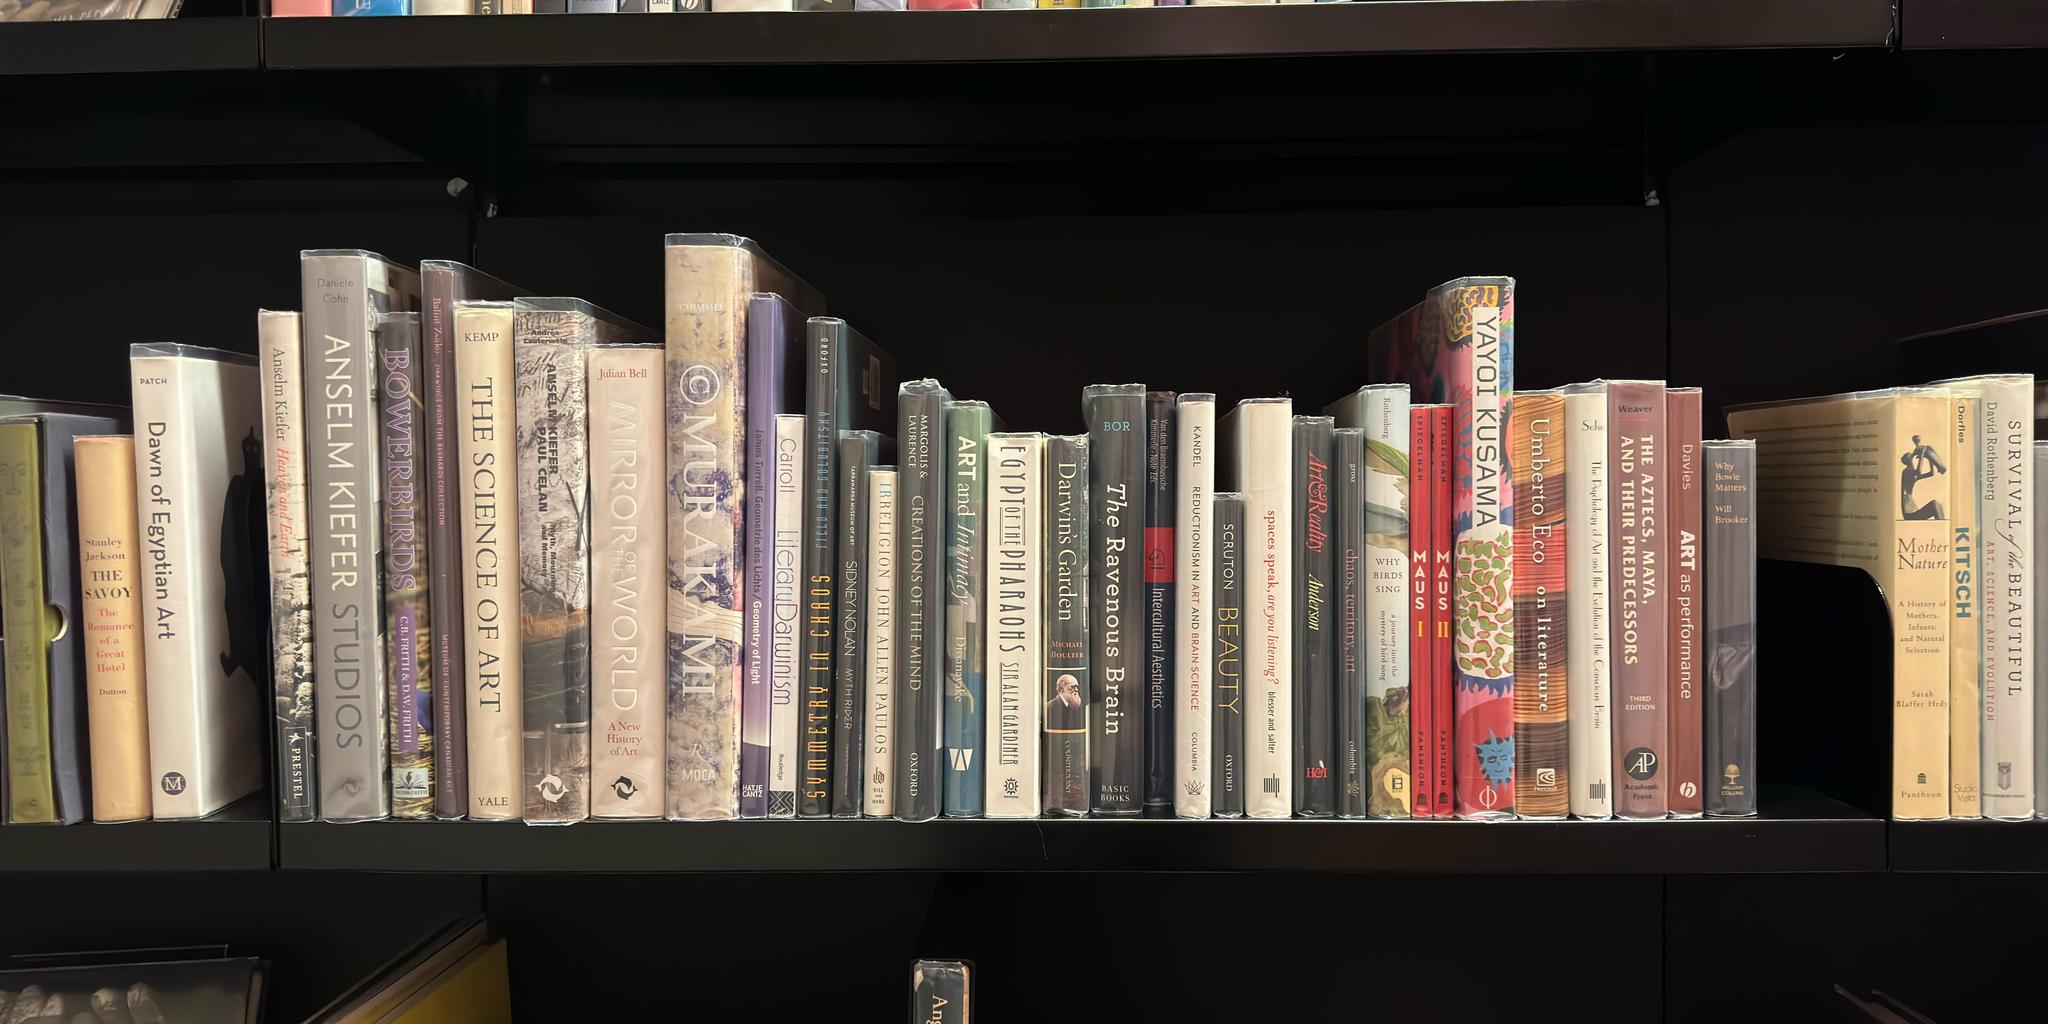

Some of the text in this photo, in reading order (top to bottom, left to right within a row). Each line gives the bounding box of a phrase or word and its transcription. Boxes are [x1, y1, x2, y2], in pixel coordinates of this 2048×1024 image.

[465, 333, 499, 342] KEMP
[820, 337, 828, 374] OXFORD
[140, 377, 167, 385] PATCH
[597, 368, 647, 380] Julian Bell
[547, 363, 558, 474] ANSELM KIEFER
[1103, 421, 1130, 432] BOR
[1381, 398, 1391, 439] Rothenberg
[1476, 316, 1497, 528] YAYOI KUSAMA
[1618, 405, 1652, 413] Weaver
[1957, 405, 1965, 443] Dorfles
[908, 415, 917, 468] LAURENCE
[919, 414, 928, 479] MARGOLIS &
[1192, 426, 1202, 466] KANDEL
[1985, 402, 1997, 501] David Rothenberg
[384, 348, 417, 592] BOWERBIRDS
[537, 426, 548, 512] PAUL CELAN
[780, 438, 796, 492] Carroll
[1682, 444, 1694, 490] Davies
[1715, 462, 1734, 471] Why
[1715, 473, 1740, 481] Bowie
[1530, 416, 1552, 563] Umberto Eco
[1715, 484, 1747, 492] Matters
[147, 420, 175, 640] Dawn of Egyptian Art
[951, 435, 977, 605] ART and Intimacy
[1640, 435, 1655, 605] THE AZTECS, MAYA,
[1715, 516, 1748, 524] Brooker
[85, 551, 126, 562] Jackson
[325, 334, 362, 749] ANSELM KIEFER STUDIOS
[472, 377, 501, 713] THE SCIENCE OF ART
[1000, 446, 1026, 653] EGYPT OF THE PHARAOHS
[1058, 462, 1078, 621] Darwin's Garden
[1223, 523, 1234, 590] SCRUTON
[1376, 558, 1400, 566] WHY
[1621, 436, 1637, 664] AND THEIR PREDECESSORS
[1898, 538, 1949, 554] Mother
[1898, 554, 1948, 570] Nature
[1995, 421, 2024, 696] SURVIVAL of the BEAUTIFUL
[84, 586, 133, 600] SAVOY
[91, 570, 122, 581] THE
[909, 495, 923, 691] CREATIONS OF THE MIND
[1375, 585, 1401, 593] SING
[1955, 527, 1971, 618] KITSCH
[97, 608, 118, 617] The
[844, 561, 857, 656] SIDNEY NOLAN
[874, 482, 893, 755] IRRELIGION JOHN ALLEN PAULOS
[1105, 483, 1128, 736] The Ravenous Brain
[1190, 486, 1201, 711] REDUCTIONISM IN ART AND BRAIN SCIENCE
[1263, 510, 1279, 685] spaces speak, are you listening?
[1678, 530, 1696, 699] ART as performance
[1907, 600, 1936, 609] History
[88, 622, 135, 632] Romance
[99, 636, 110, 645] of
[1986, 541, 1994, 721] ART, SCIENCE, AND EVOLUTION
[96, 650, 125, 659] Great
[96, 663, 126, 672] Hotel
[1151, 588, 1166, 709] Intercultural Aesthetics
[1218, 607, 1239, 714] BEAUTY
[1380, 648, 1388, 663] bird
[1537, 586, 1551, 712] on literature
[1002, 662, 1019, 765] SIR ALAN GARDINER
[1911, 690, 1934, 698] Sarah
[607, 734, 642, 745] History
[608, 722, 640, 731] A New
[1267, 691, 1276, 754] blesser and salter
[610, 747, 640, 756] of Art
[291, 748, 303, 800] PRESTEL
[682, 769, 717, 781] MOCA
[910, 752, 919, 796] OXFORD
[1101, 785, 1129, 793] BASIC
[1225, 754, 1234, 792] OXFORD
[479, 797, 509, 806] YALE
[1101, 794, 1130, 802] BOOKS
